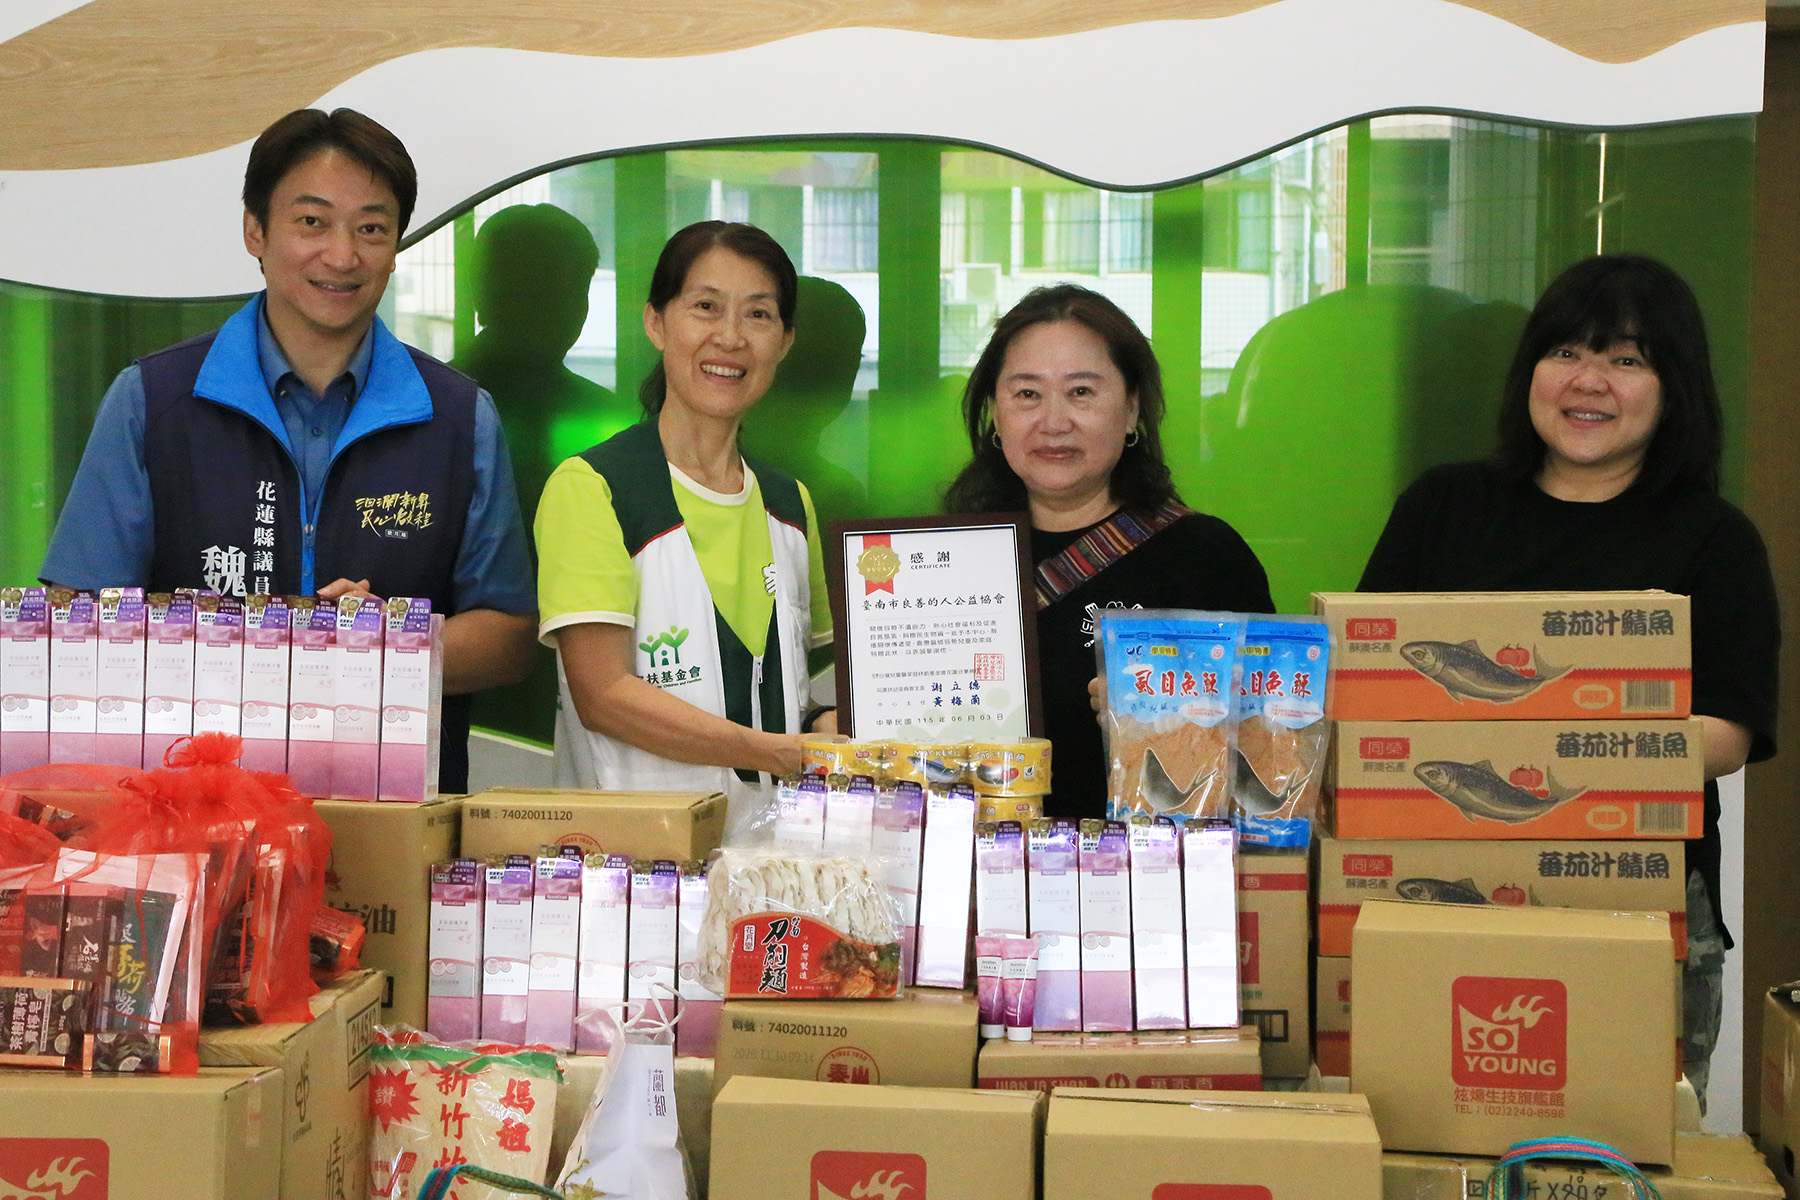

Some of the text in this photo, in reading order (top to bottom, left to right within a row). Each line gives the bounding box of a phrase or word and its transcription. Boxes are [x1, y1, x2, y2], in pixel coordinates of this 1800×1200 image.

[253, 481, 277, 596] 花蓮縣議員
[910, 551, 950, 564] 感謝
[201, 544, 247, 597] 魏
[1354, 622, 1389, 636] 同榮
[1541, 609, 1674, 637] 蕃茄汁鯖魚
[638, 666, 700, 685] 扶基金會
[1240, 670, 1312, 699] 目魚酥
[1367, 741, 1403, 755] 同榮
[1556, 732, 1688, 759] 蕃茄汁鯖魚
[502, 809, 573, 821] 74020011120
[1351, 858, 1385, 872] 同榮
[1538, 851, 1670, 880] 蕃茄汁鯖魚
[768, 1022, 847, 1037] 74020011120
[1467, 1027, 1514, 1052] SO
[1464, 1055, 1557, 1076] YOUNG
[375, 1087, 396, 1108] 讚
[496, 1078, 535, 1153] 媽祖
[1484, 1104, 1565, 1119] (02)2240-8596
